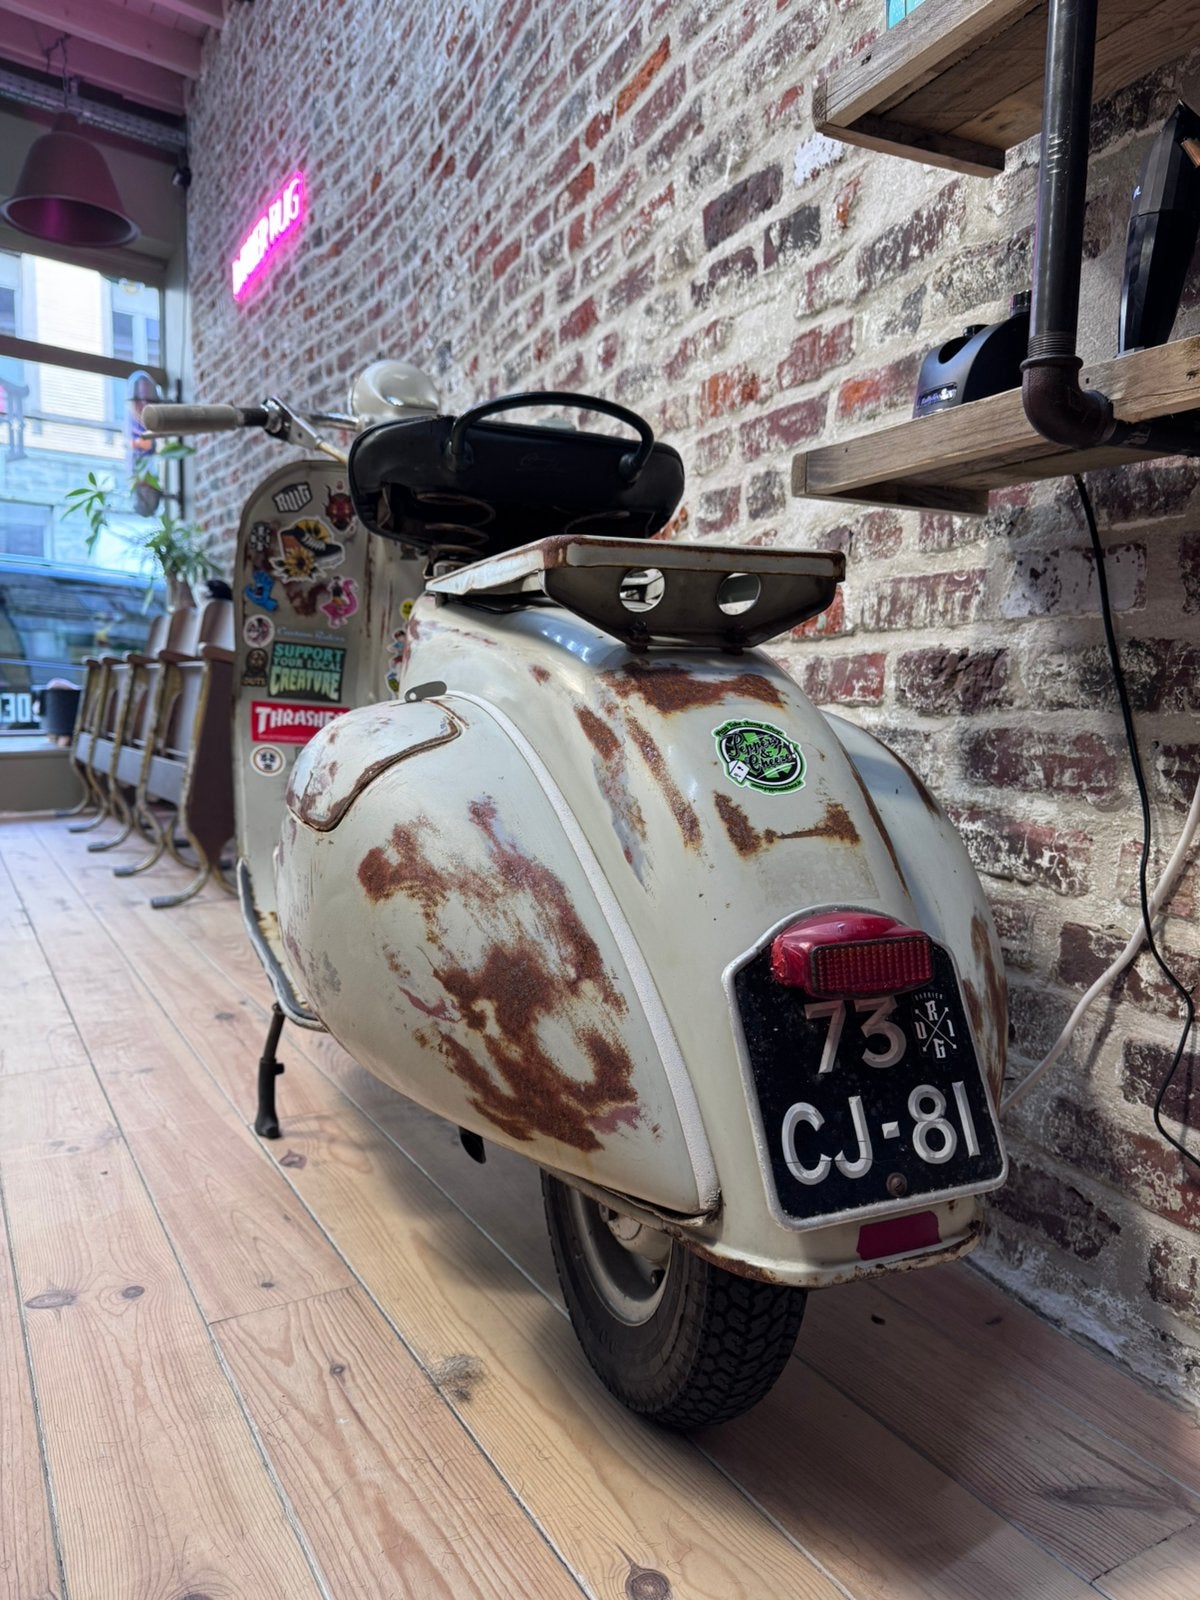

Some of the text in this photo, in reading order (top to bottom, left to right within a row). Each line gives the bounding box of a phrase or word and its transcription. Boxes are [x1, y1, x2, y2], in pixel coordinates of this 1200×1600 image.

[273, 656, 342, 672] YOUR LOCAL
[274, 643, 344, 662] SUPPORT
[269, 666, 340, 701] CREATURE
[804, 996, 907, 1074] 73
[782, 1081, 981, 1186] CJ-81
